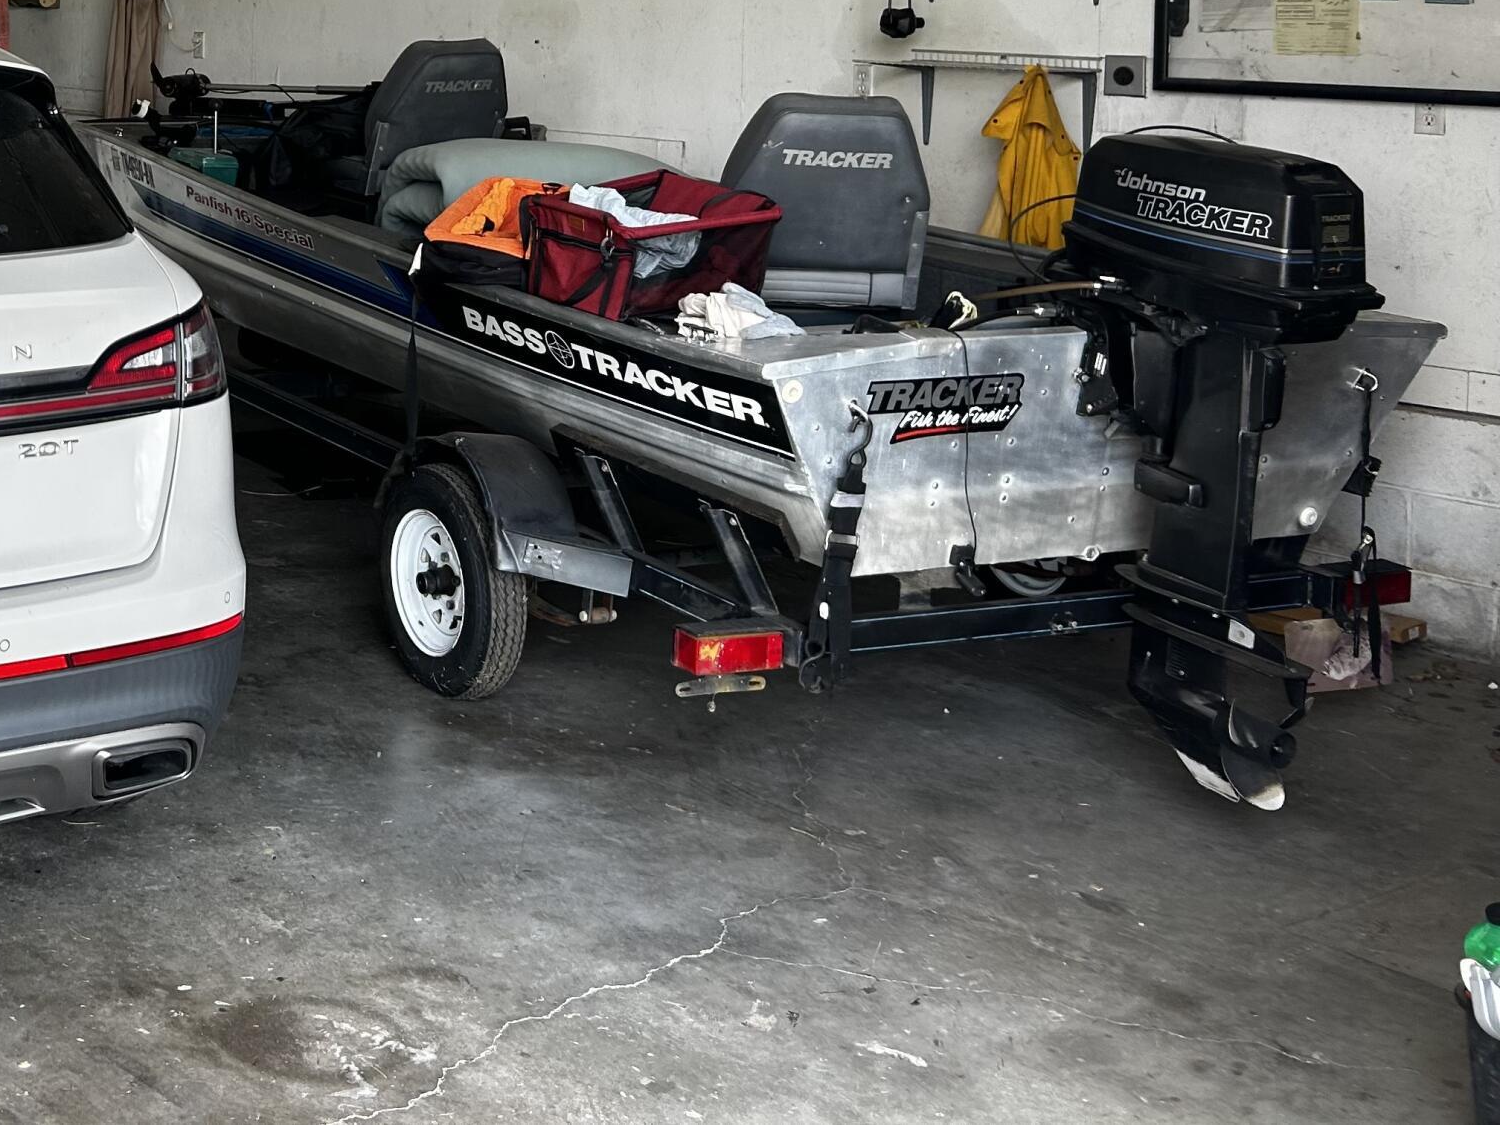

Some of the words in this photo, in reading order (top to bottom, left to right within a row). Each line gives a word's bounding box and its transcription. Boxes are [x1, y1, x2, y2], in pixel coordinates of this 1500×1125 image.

[425, 78, 493, 93] TRACKER
[782, 148, 893, 169] TRACKER
[1117, 170, 1207, 201] Johnson
[186, 185, 233, 217] Panfish
[235, 207, 251, 224] 16
[253, 214, 315, 251] Special
[1137, 193, 1273, 239] TRACKER
[462, 306, 547, 355] BASS
[571, 343, 767, 427] TRACKER
[869, 375, 1021, 412] TRACKER
[900, 410, 934, 428] Fish
[935, 410, 959, 426] the
[961, 404, 1019, 424] Finest!
